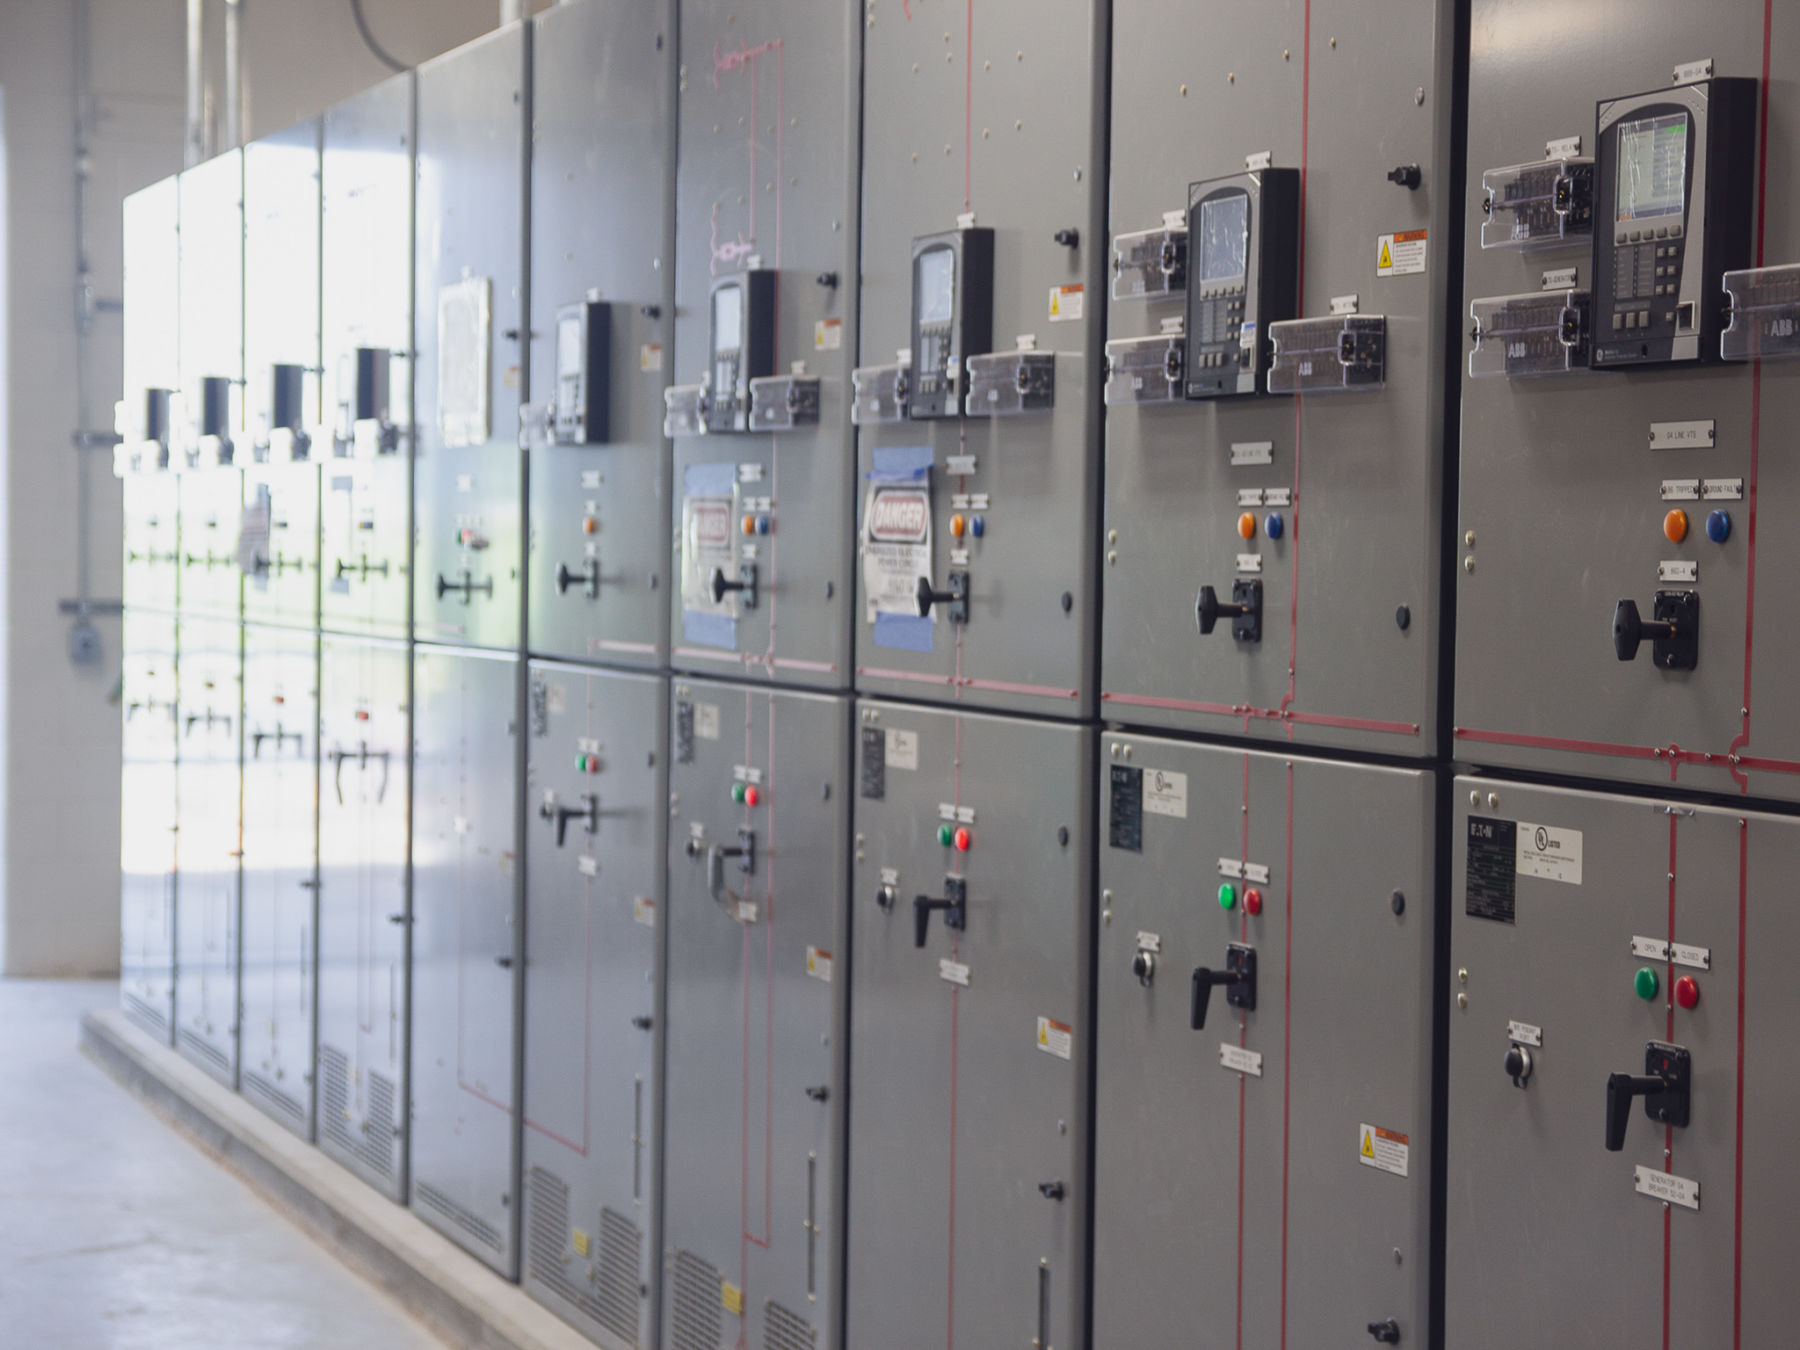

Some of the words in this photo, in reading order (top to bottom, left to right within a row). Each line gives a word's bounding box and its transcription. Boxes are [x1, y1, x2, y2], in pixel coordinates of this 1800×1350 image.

[1770, 319, 1793, 337] ABB
[1508, 342, 1526, 358] ABB
[1298, 361, 1312, 376] ABB
[876, 502, 923, 528] DANGER
[1644, 943, 1657, 953] OPEN
[1681, 951, 1699, 961] CLOSED
